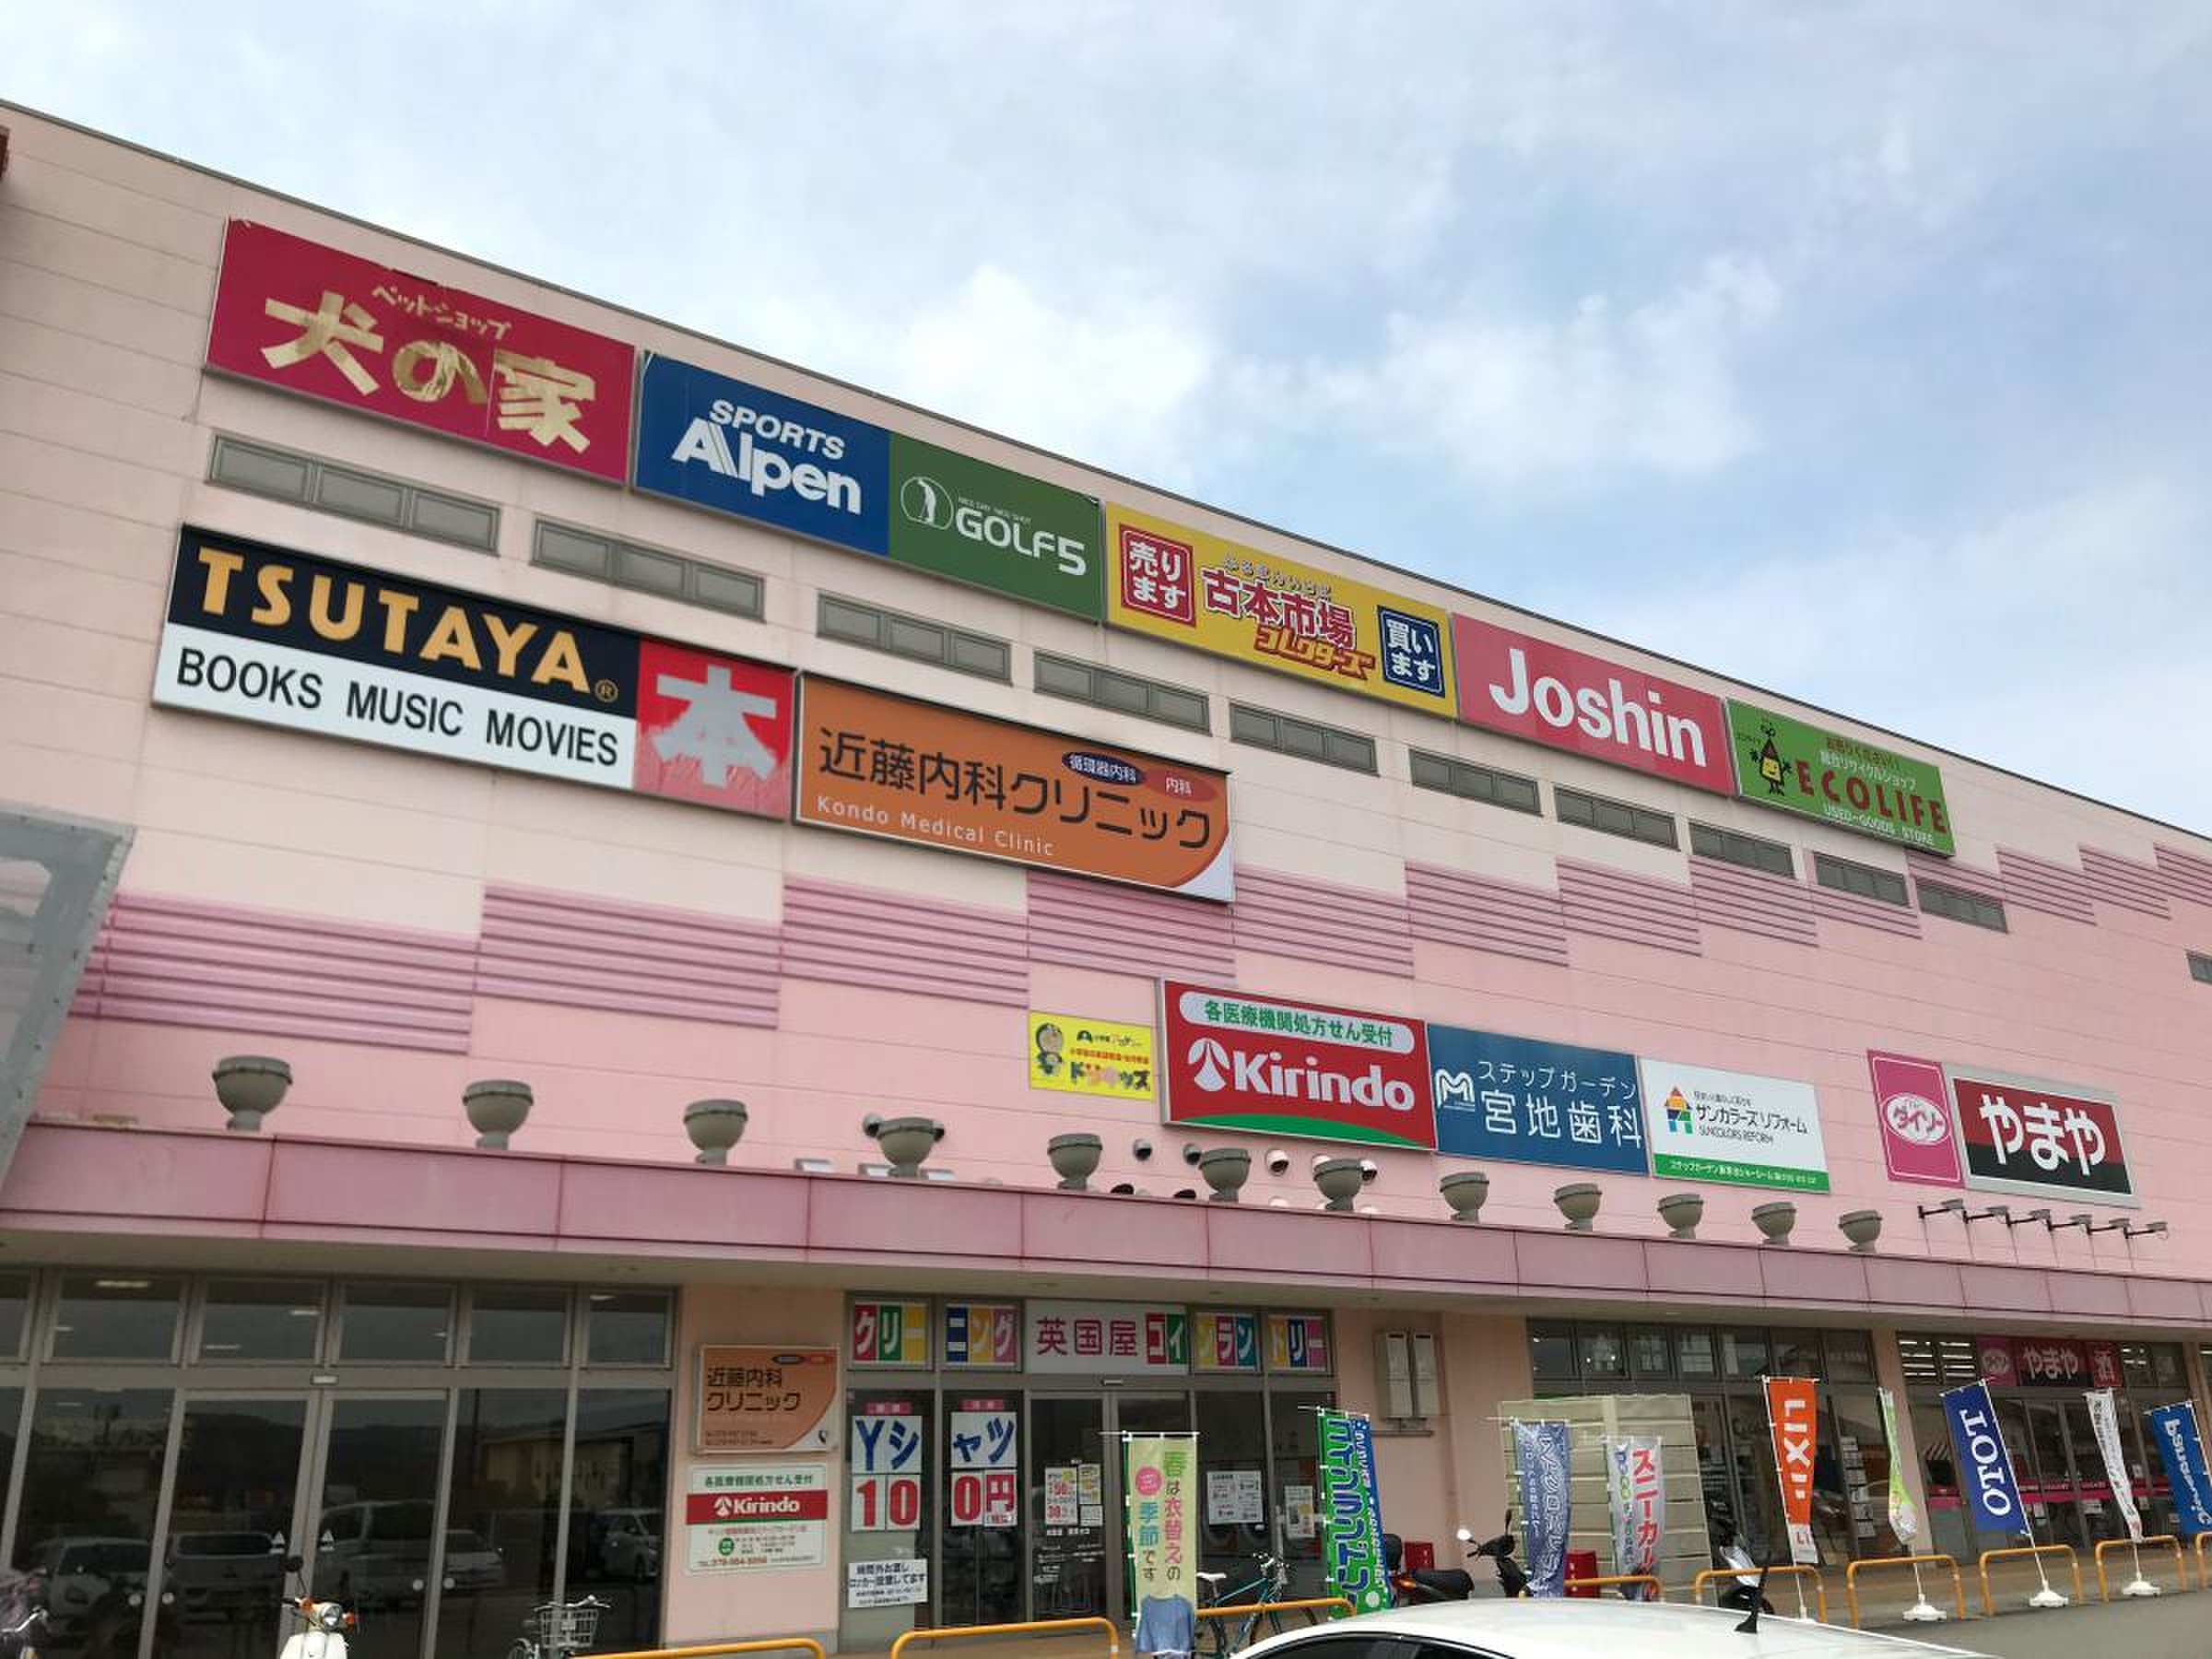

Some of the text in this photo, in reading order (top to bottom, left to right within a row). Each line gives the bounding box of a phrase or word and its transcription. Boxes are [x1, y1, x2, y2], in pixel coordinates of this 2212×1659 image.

[260, 290, 596, 454] 犬の家
[709, 398, 845, 461] SPORTS
[670, 417, 863, 516] Alpen
[956, 507, 1087, 576] GOLF5
[1129, 540, 1182, 580] 売り
[197, 546, 591, 695] TSUTAYA
[1132, 573, 1186, 610] ます
[1201, 567, 1358, 651] 古本市場
[1386, 618, 1434, 654] 買い
[1390, 651, 1437, 683] ます
[177, 647, 619, 768] BOOKS MUSIC MOVIES
[653, 663, 778, 788] 本
[1489, 648, 1707, 768] Joshin
[818, 725, 1212, 850] 近藤内科クリニック
[1166, 776, 1193, 797] 内科
[1795, 759, 1947, 833] ECOLIFE
[816, 794, 1055, 857] Kondo Medical Clinic
[1205, 998, 1394, 1048] 各医療機関処方せん受付
[1232, 1051, 1416, 1112] Kirindo
[1478, 1060, 1637, 1100] ステップガーデン
[1480, 1089, 1642, 1149] 宮地歯科
[1979, 1093, 2106, 1176] やまや
[855, 1312, 1016, 1358] クリー ニング
[1036, 1317, 1138, 1357] 英国屋
[2023, 1345, 2079, 1381] やまや
[707, 1392, 801, 1412] クリニック
[854, 1417, 1016, 1472] Yシ ャツ
[733, 1495, 801, 1514] Kirindo
[855, 1478, 919, 1527] 10
